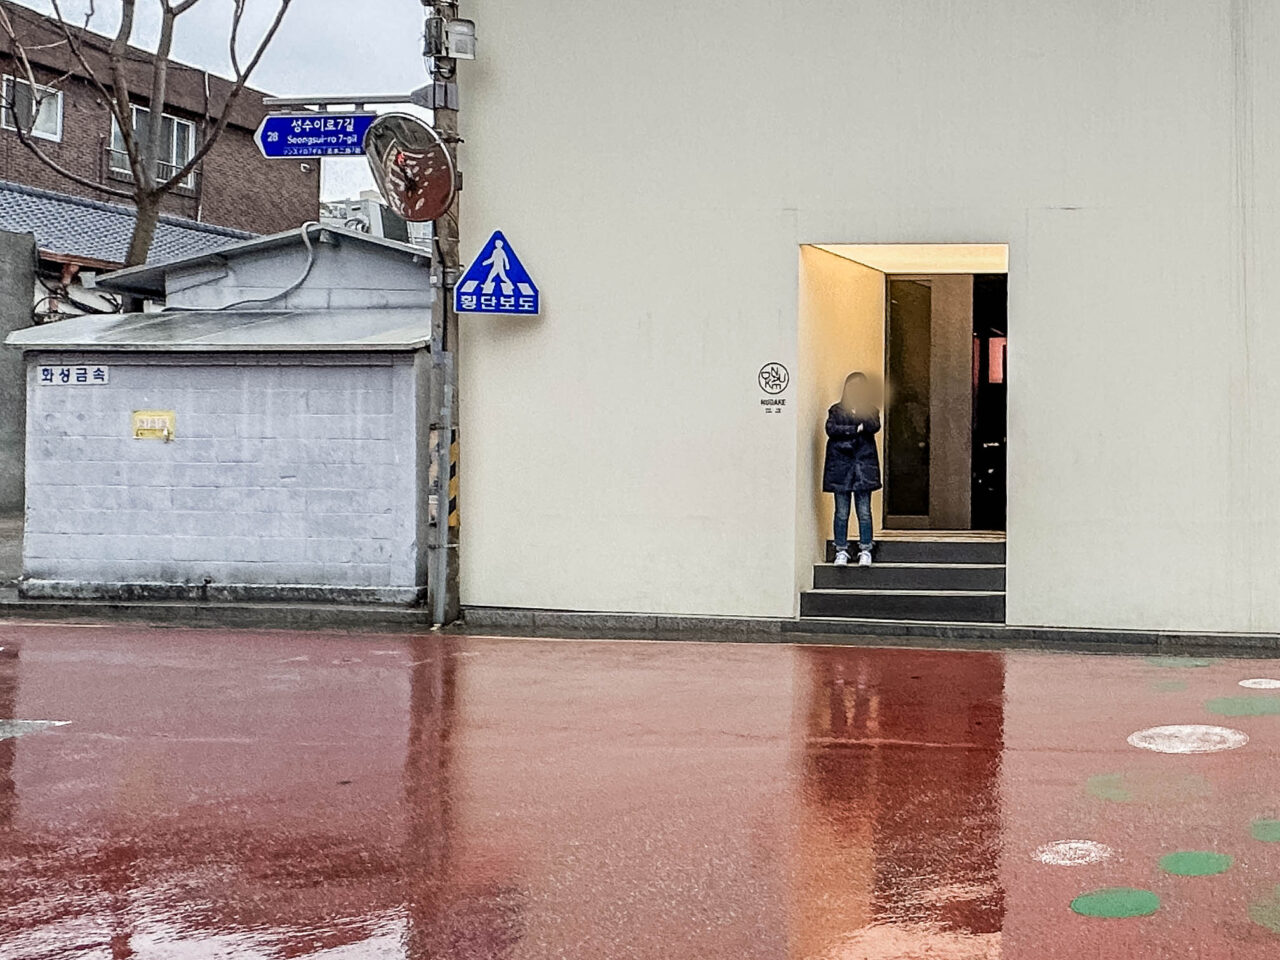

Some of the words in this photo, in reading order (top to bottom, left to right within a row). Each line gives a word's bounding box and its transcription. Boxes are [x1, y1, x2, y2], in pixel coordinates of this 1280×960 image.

[291, 118, 355, 133] 성수이로7길
[287, 134, 337, 146] Seongsui-ro
[460, 294, 535, 311] 횡단보도
[41, 367, 106, 383] 화성금속
